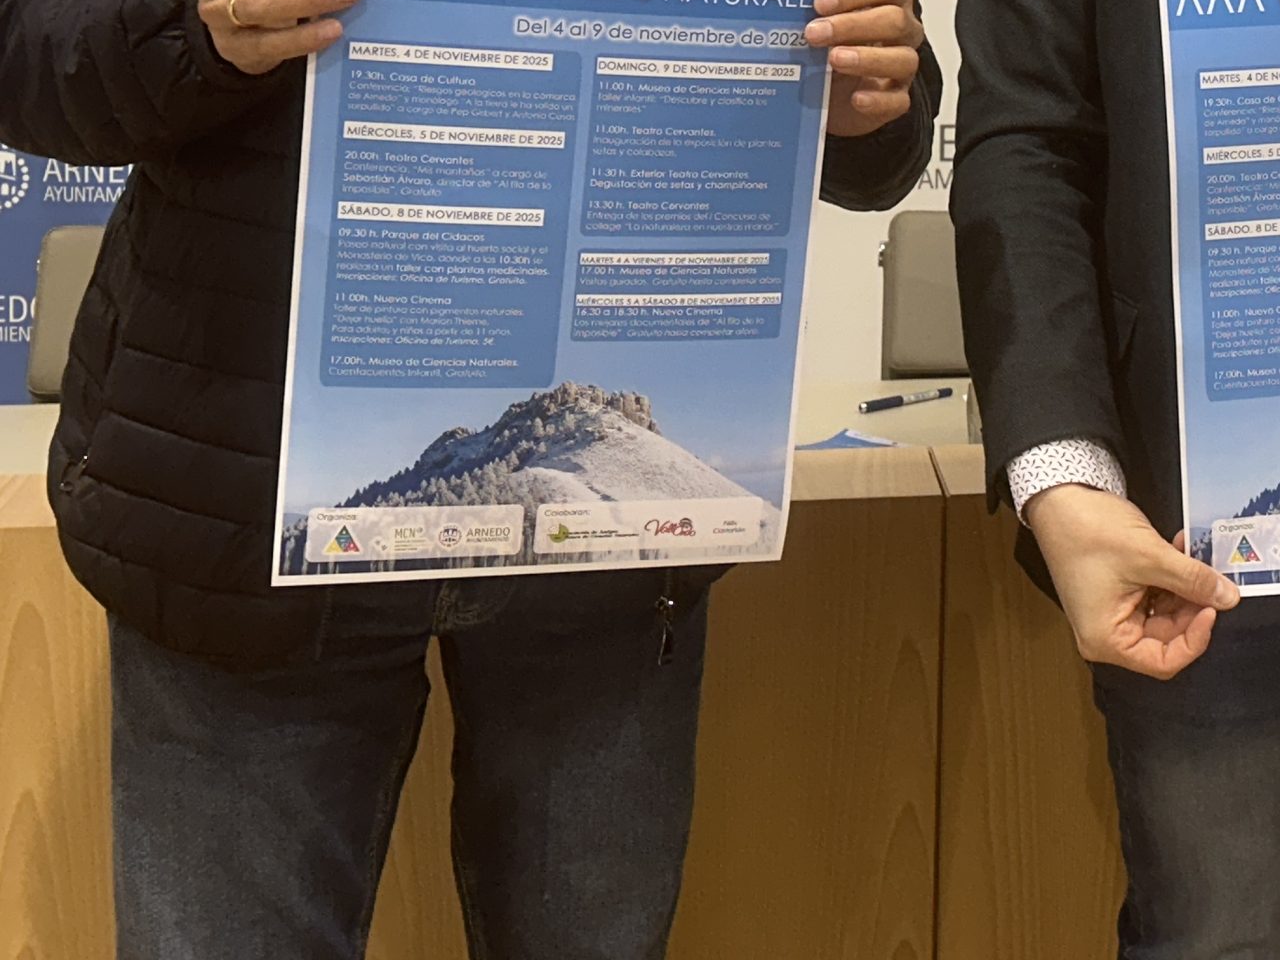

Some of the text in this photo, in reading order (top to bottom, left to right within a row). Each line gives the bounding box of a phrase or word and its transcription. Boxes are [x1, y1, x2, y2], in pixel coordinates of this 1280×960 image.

[515, 18, 547, 35] Del
[552, 20, 565, 36] 4
[569, 21, 586, 37] al
[591, 22, 602, 38] 9
[607, 23, 633, 39] de
[638, 24, 735, 44] noviembre
[740, 29, 764, 46] de
[403, 48, 411, 59] 4
[414, 48, 430, 60] DE
[433, 49, 498, 63] NOVIEMBRE
[501, 53, 518, 64] DE
[521, 54, 548, 66] 2025
[663, 62, 670, 73] 9
[673, 63, 688, 74] DE
[690, 63, 750, 76] NOVIEMBRE
[753, 66, 768, 77] DE
[771, 66, 795, 78] 2025
[1246, 73, 1253, 84] 4
[1255, 72, 1268, 83] DE
[419, 130, 426, 139] 5
[429, 130, 445, 140] DE
[448, 131, 515, 143] NOVIEMBRE
[518, 134, 533, 144] DE
[536, 135, 562, 145] 2025
[397, 208, 403, 217] 8
[407, 208, 422, 217] DE
[426, 209, 493, 220] NOVIEMBRE
[496, 211, 511, 220] DE
[514, 211, 541, 221] 2025
[1255, 223, 1261, 233] 8
[1264, 222, 1277, 232] DE
[467, 527, 510, 537] ARNEDO
